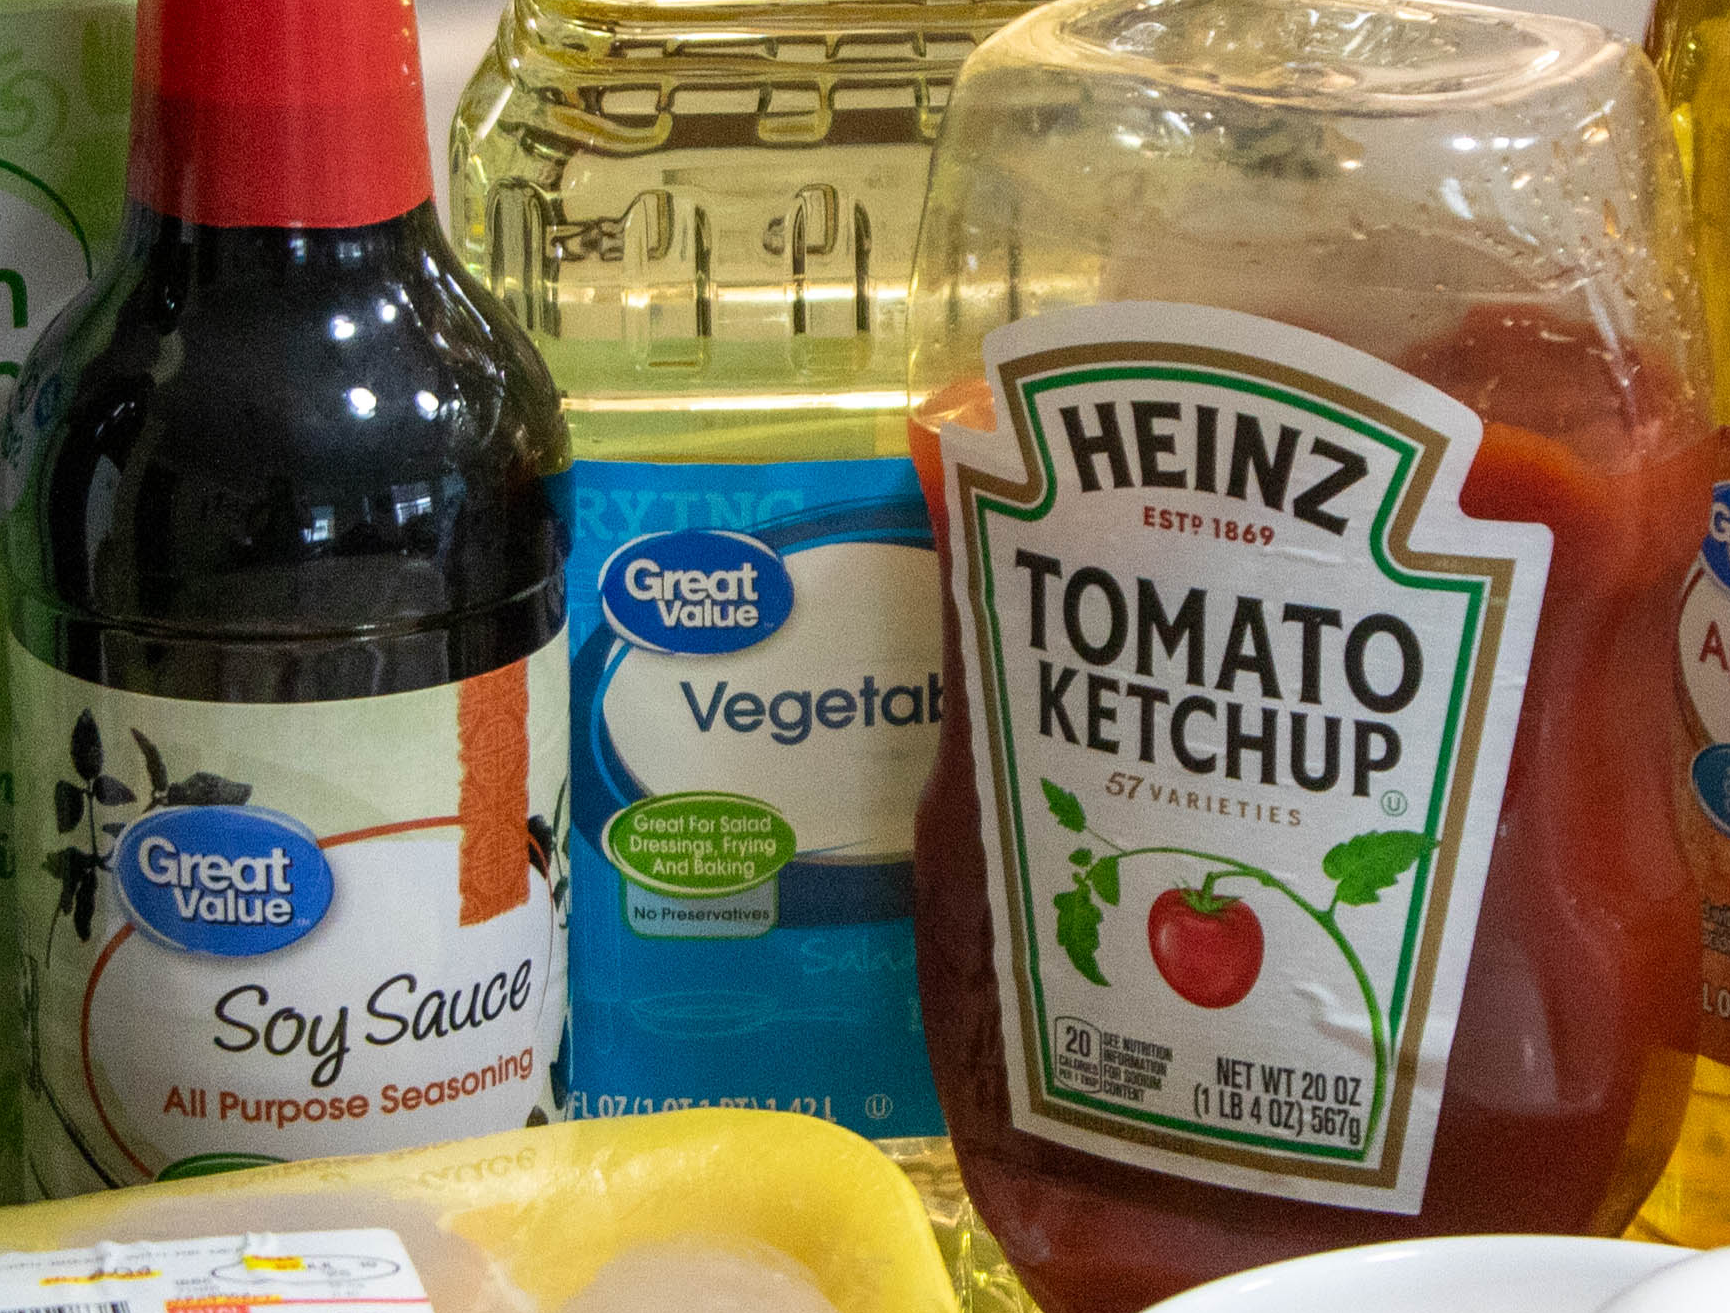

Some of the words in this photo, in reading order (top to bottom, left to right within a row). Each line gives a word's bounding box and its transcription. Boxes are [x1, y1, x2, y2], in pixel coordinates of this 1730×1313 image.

[1059, 401, 1369, 536] HEINZ
[1211, 517, 1276, 547] 1869
[625, 558, 758, 601] Great
[657, 598, 759, 628] Value
[1016, 549, 1424, 713] TOMATO
[1038, 660, 1402, 798] KETCHUP
[1105, 772, 1145, 801] 57
[1150, 785, 1303, 828] VARIETIES
[633, 814, 685, 833] Great
[689, 815, 715, 833] For
[722, 816, 771, 833] Salad
[138, 835, 293, 893] Great
[630, 836, 718, 856] Dressings,
[723, 836, 776, 857] Frying
[653, 859, 688, 876] And
[694, 860, 755, 878] Baking
[174, 888, 293, 926] Value
[634, 907, 657, 920] No
[662, 908, 769, 921] Preservatives
[213, 984, 351, 1088] Soy
[365, 958, 533, 1048] Sauce
[1065, 1026, 1091, 1057] 20
[1103, 1049, 1167, 1077] INFORMATION
[1216, 1056, 1255, 1091] NET
[1261, 1064, 1296, 1097] WT
[1301, 1071, 1328, 1102] 20
[1334, 1077, 1362, 1107] OZ
[163, 1086, 207, 1120] All
[220, 1090, 369, 1129] Purpose
[380, 1046, 534, 1116] Seasoning
[1194, 1083, 1210, 1119] (1
[1219, 1092, 1244, 1121] LB
[1250, 1096, 1263, 1124] 4
[1269, 1100, 1304, 1137] OZ)
[1311, 1106, 1361, 1146] 567g
